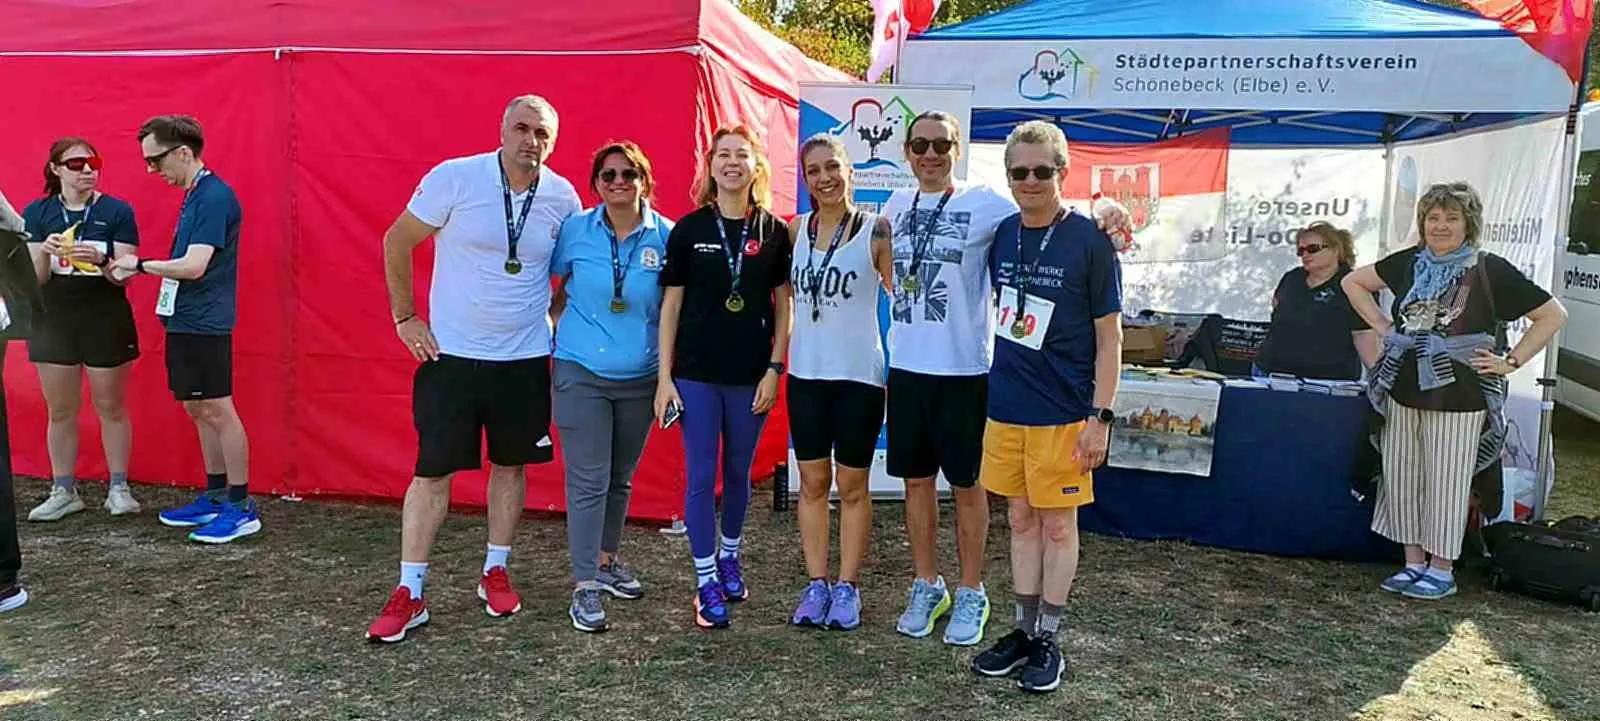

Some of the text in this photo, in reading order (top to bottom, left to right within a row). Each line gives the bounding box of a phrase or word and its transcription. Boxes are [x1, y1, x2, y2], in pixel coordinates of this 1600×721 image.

[1115, 53, 1417, 71] Städtepartnerschaftsverein
[1113, 76, 1225, 92] Schönebeck
[1233, 76, 1288, 94] (Elbe)
[1317, 78, 1336, 93] V.
